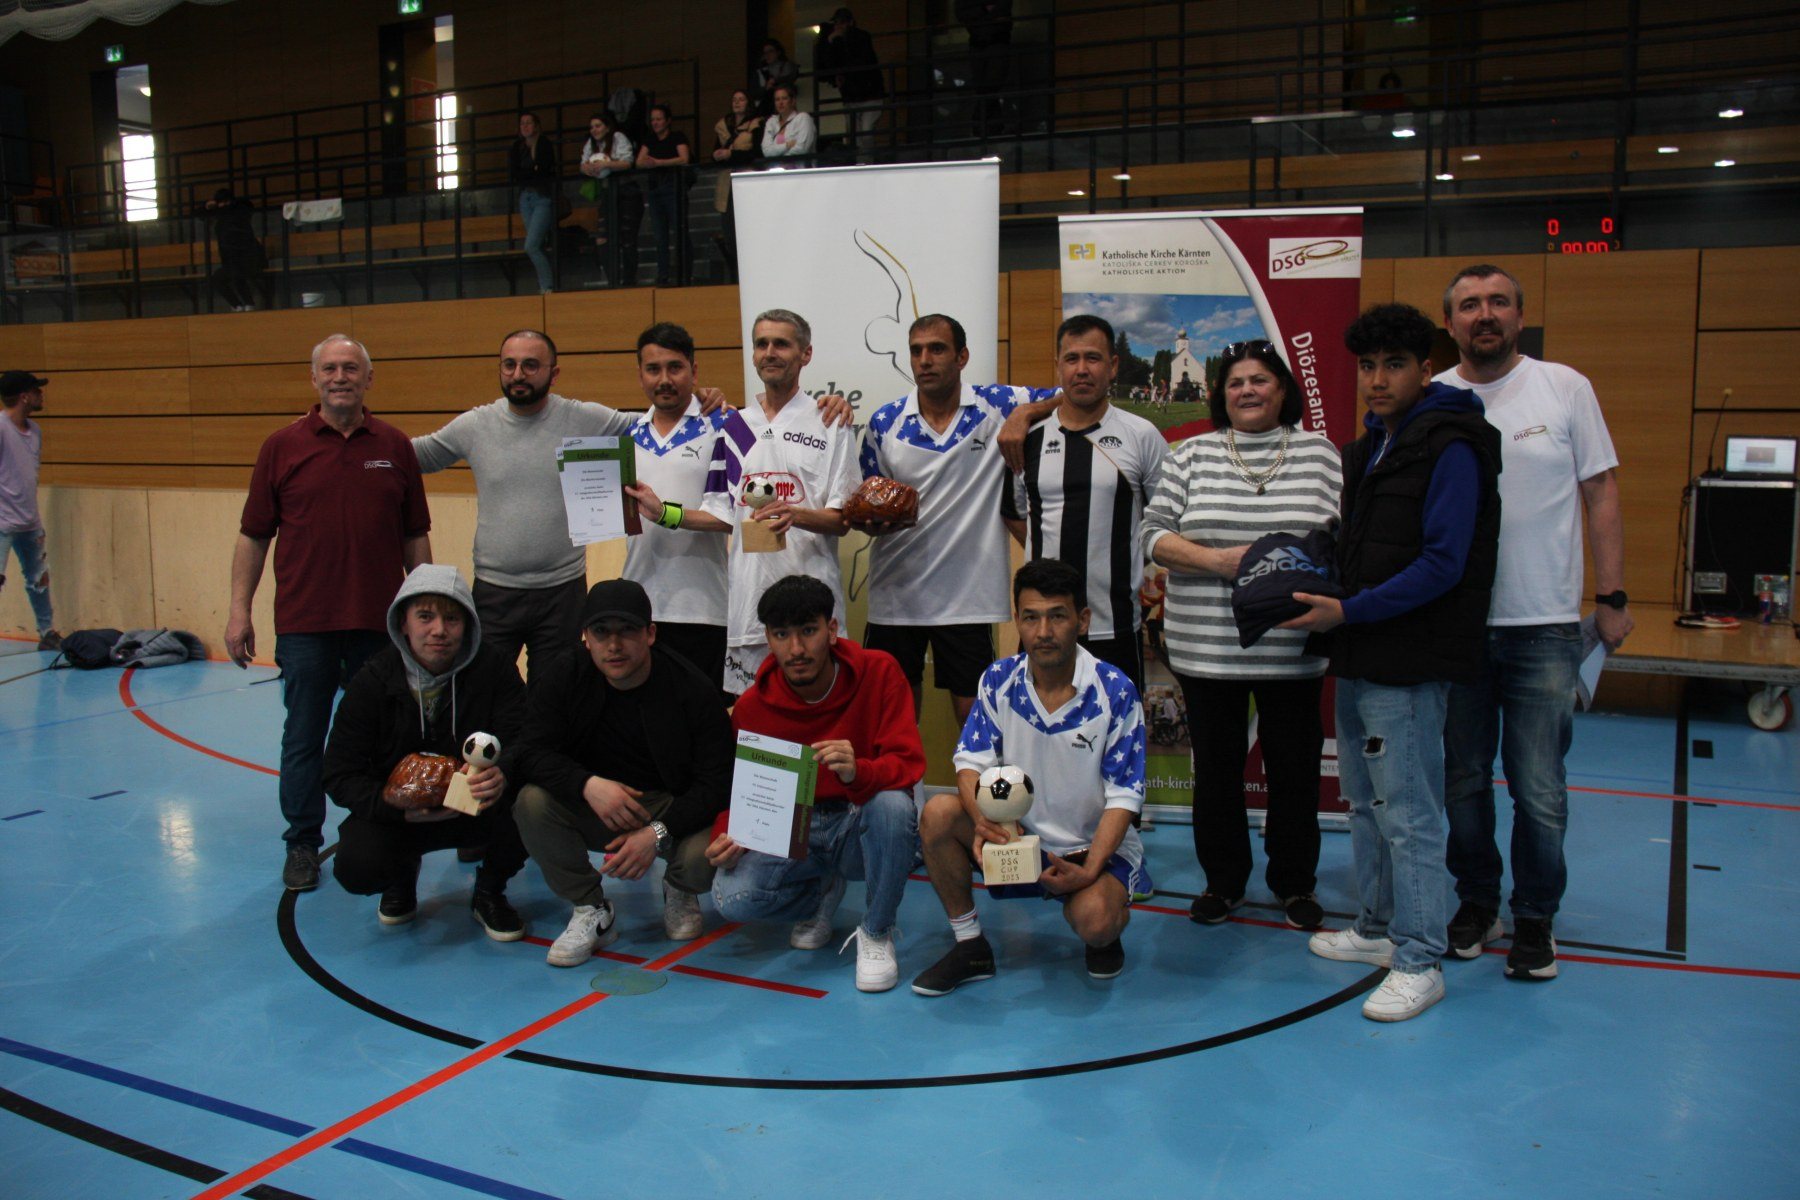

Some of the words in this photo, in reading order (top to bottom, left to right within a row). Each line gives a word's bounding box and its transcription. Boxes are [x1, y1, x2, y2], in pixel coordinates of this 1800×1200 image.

[1546, 218, 1560, 236] 0
[1601, 216, 1614, 234] 0
[1103, 250, 1148, 260] Katholische
[1151, 249, 1176, 259] Kirche
[1179, 248, 1211, 258] Kärnten
[1272, 252, 1305, 272] DSG
[783, 431, 827, 450] adidas
[1513, 431, 1529, 441] DSG
[752, 751, 788, 768] Urkunde
[1001, 858, 1019, 866] DSG
[1001, 874, 1020, 882] 2023
